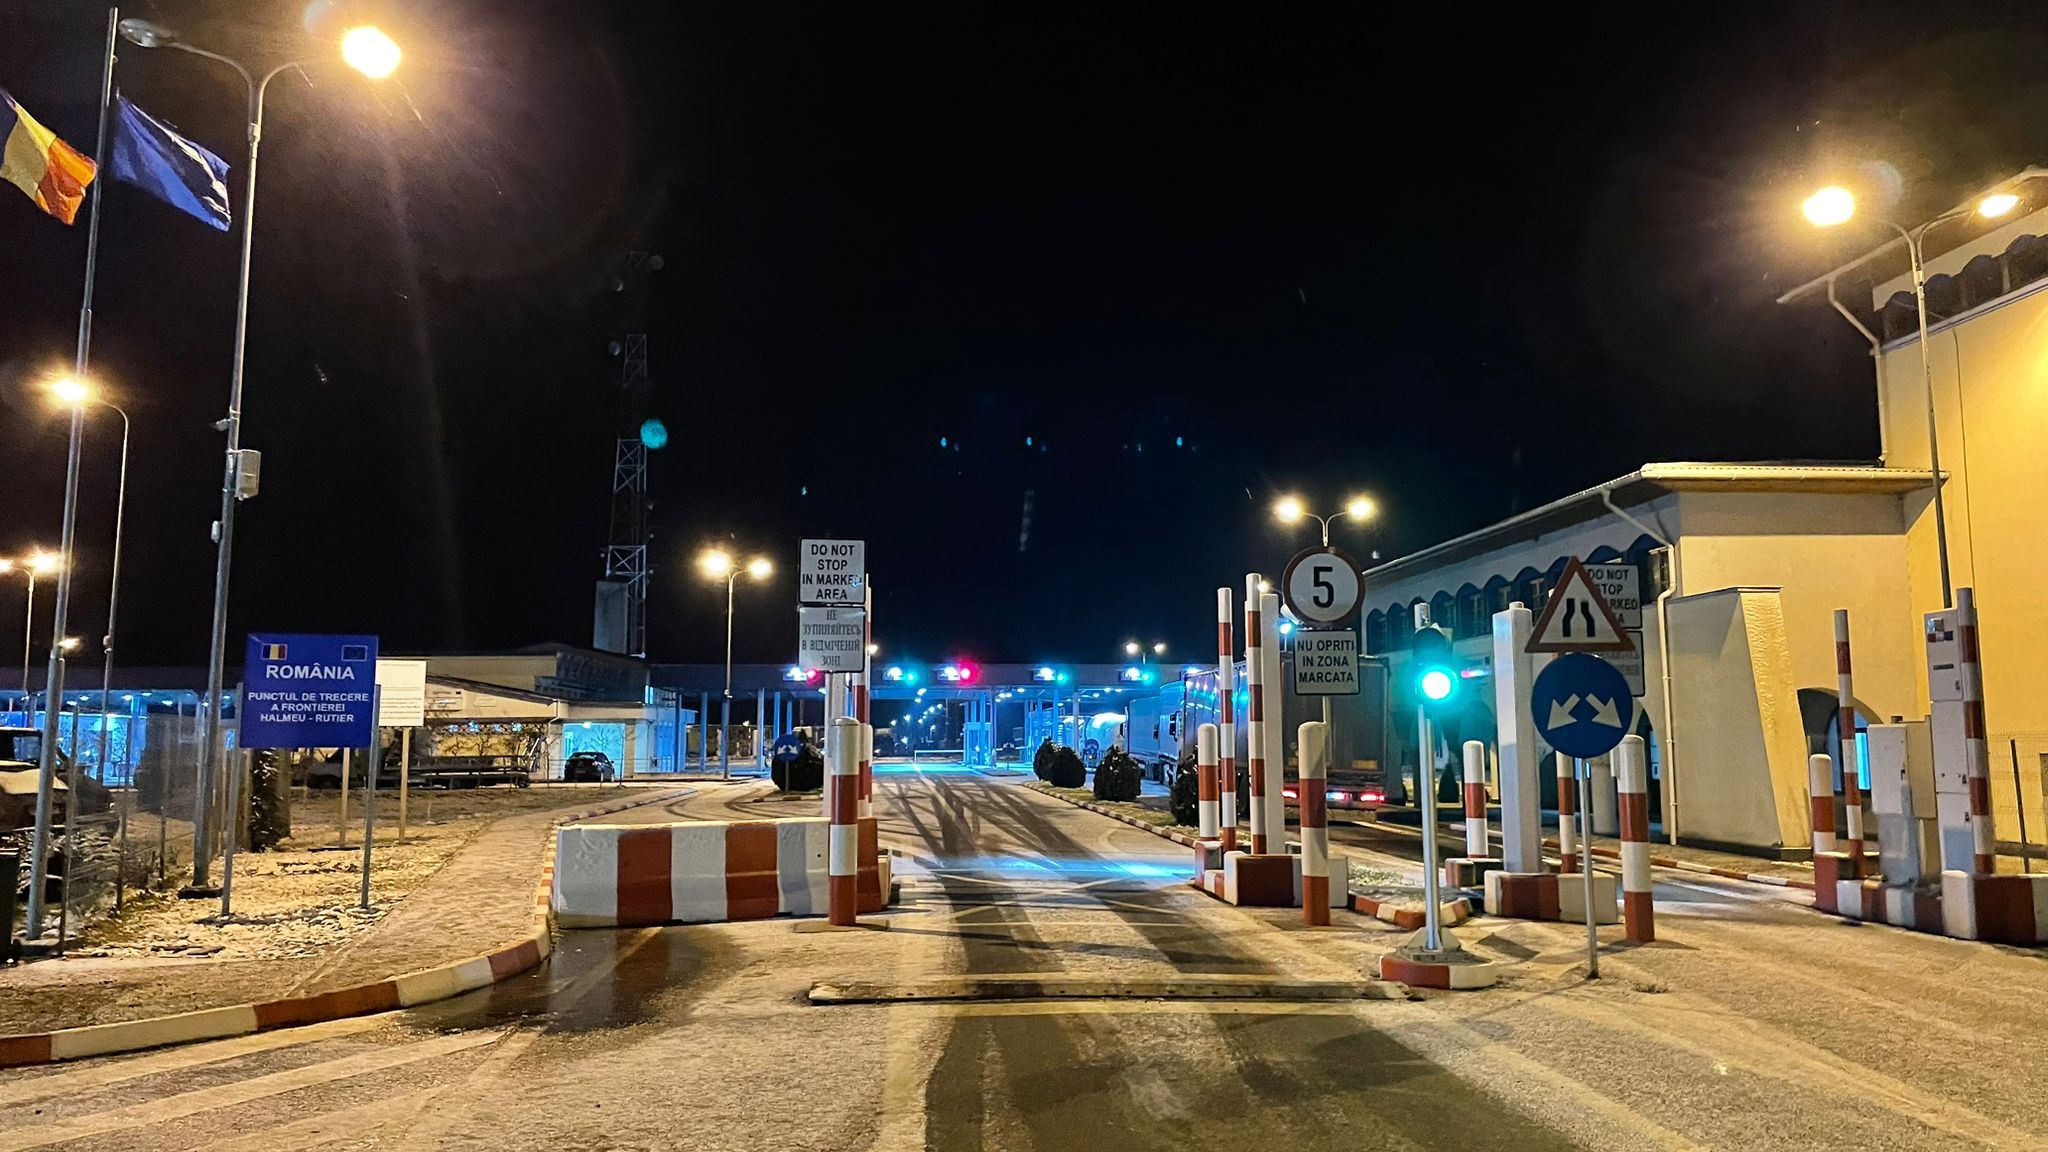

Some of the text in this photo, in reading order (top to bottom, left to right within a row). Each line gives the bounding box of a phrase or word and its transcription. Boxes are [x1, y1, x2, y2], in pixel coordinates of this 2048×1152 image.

[811, 544, 855, 556] DO NOT
[817, 559, 848, 571] STOP
[802, 573, 813, 585] IN
[1606, 569, 1630, 581] NOT
[1312, 566, 1335, 608] 5
[1600, 583, 1624, 596] TOP
[816, 588, 848, 600] AREA
[1609, 598, 1639, 610] RKED
[1297, 640, 1354, 651] NU OPRITI
[1302, 655, 1350, 667] IN ZONA
[265, 662, 355, 680] ROMÂNIA
[1299, 671, 1354, 683] MARCATA
[248, 692, 369, 702] PUNCTUL DE TRECERE
[270, 703, 346, 712] A FRONTIEREI
[260, 713, 307, 722] HALMEU
[315, 713, 355, 723] RUTIER
